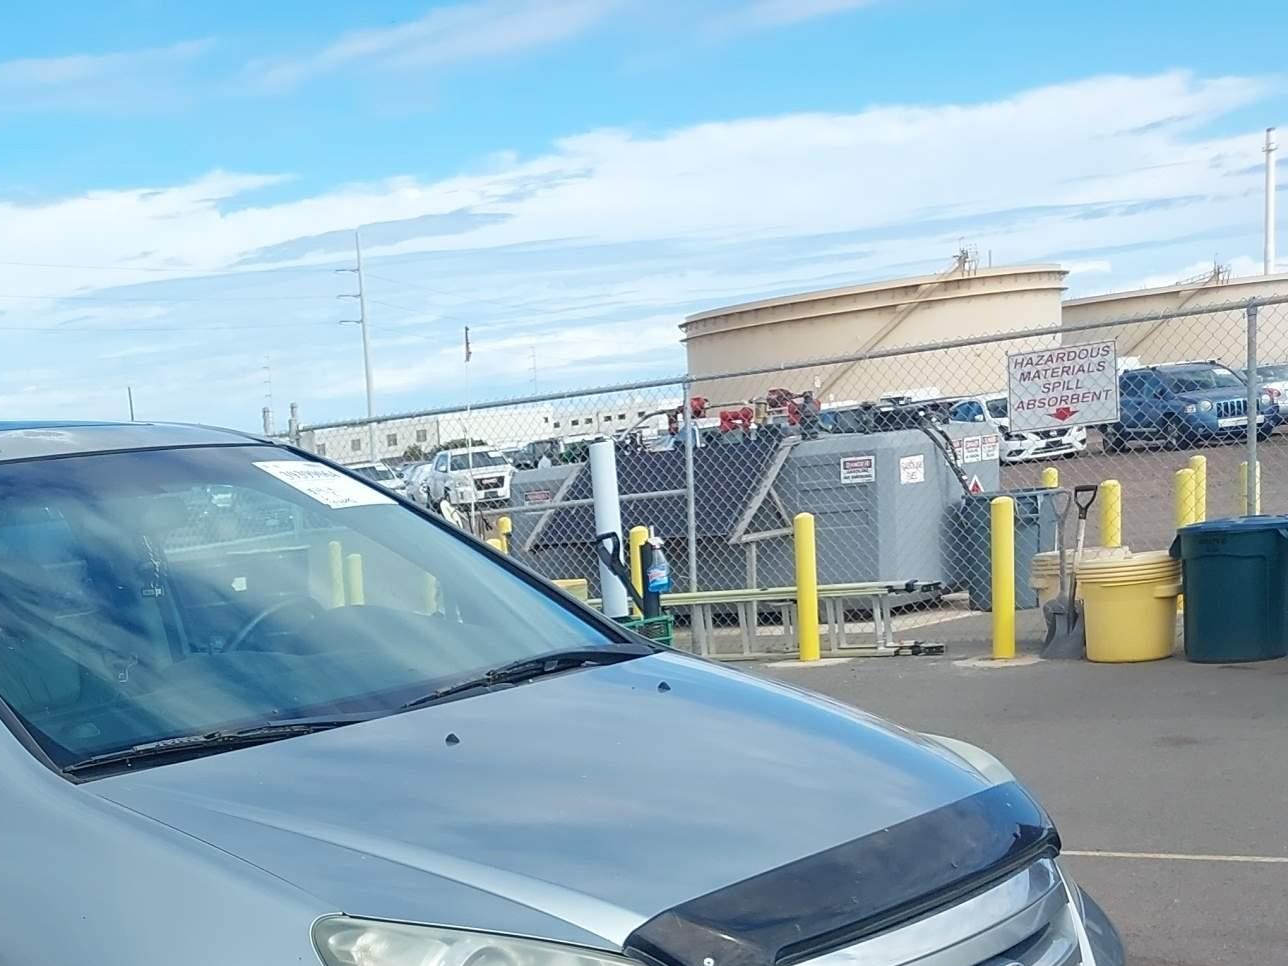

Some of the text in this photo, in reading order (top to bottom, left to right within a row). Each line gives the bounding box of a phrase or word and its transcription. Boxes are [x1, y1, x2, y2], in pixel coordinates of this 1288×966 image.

[1014, 345, 1110, 369] HAZARDOUS
[1019, 361, 1106, 382] MATERIALS
[1041, 379, 1083, 394] SPILL
[1015, 389, 1112, 412] ABSORBENT
